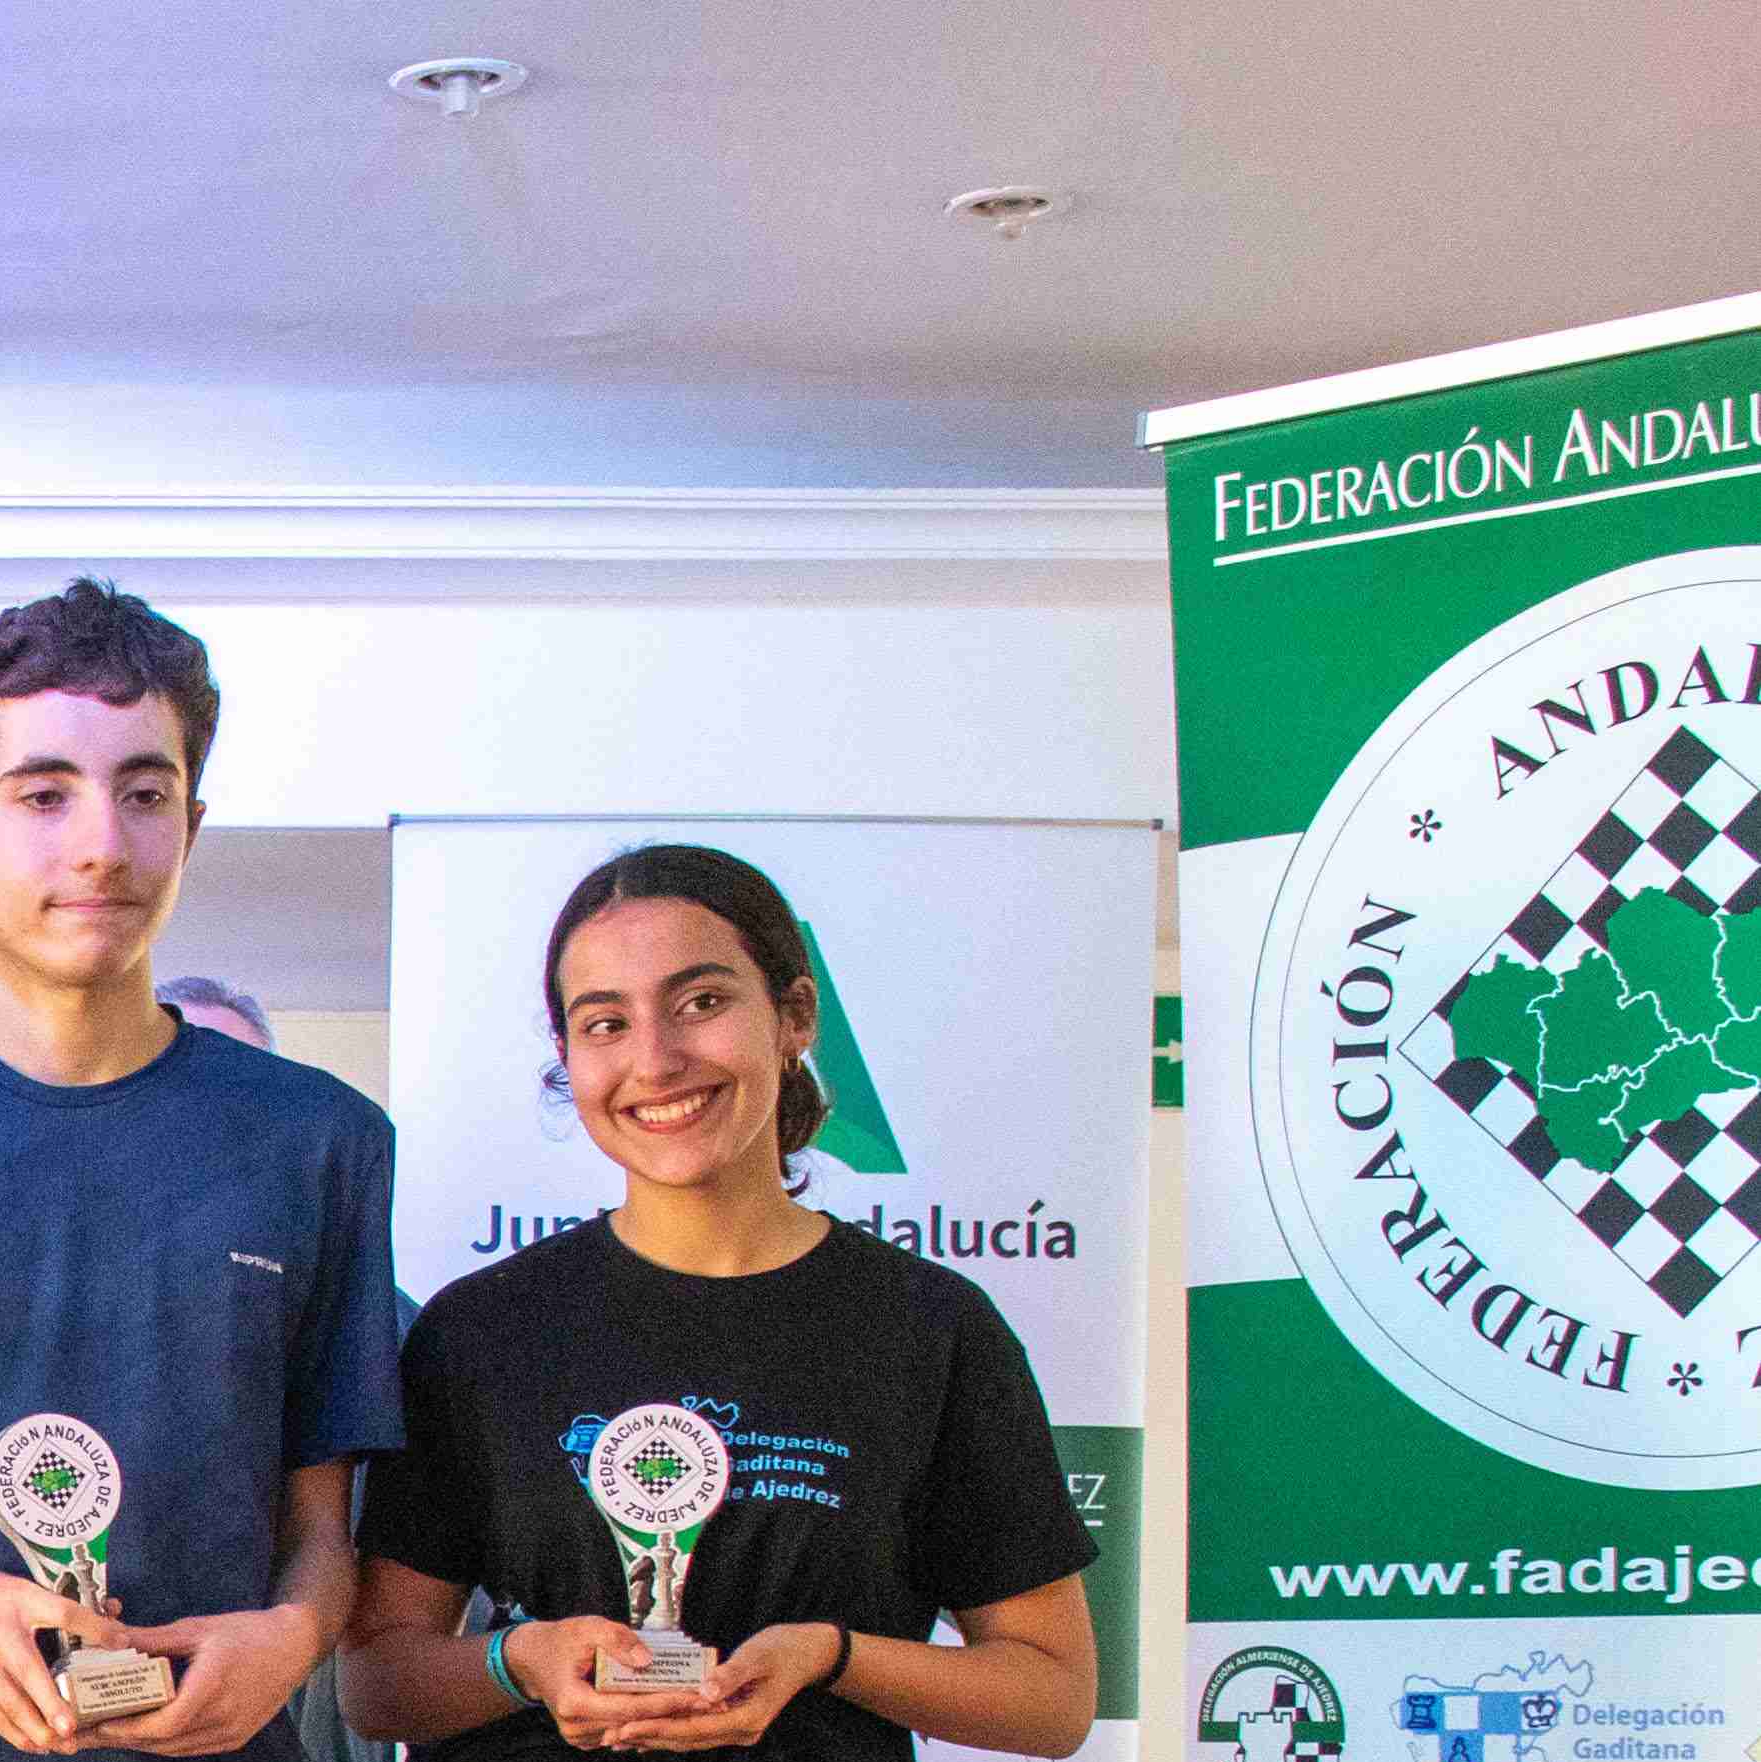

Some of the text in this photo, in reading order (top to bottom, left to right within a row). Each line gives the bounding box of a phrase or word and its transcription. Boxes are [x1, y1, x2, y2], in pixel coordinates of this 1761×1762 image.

[1214, 426, 1533, 542] FEDERACIÓN
[1318, 892, 1642, 1393] FEDERACIÓN
[44, 1424, 110, 1481] ANDALUZA
[659, 1415, 718, 1478] ANDALUZA
[729, 1455, 827, 1476] aditana
[95, 1486, 112, 1508] DE
[695, 1482, 715, 1503] DE
[752, 1479, 842, 1509] Ajedrez
[34, 1507, 101, 1538] AJEDREZ
[623, 1499, 698, 1524] AJEDREZ
[1572, 1703, 1725, 1732] Delegación
[1572, 1737, 1696, 1760] Gaditana
